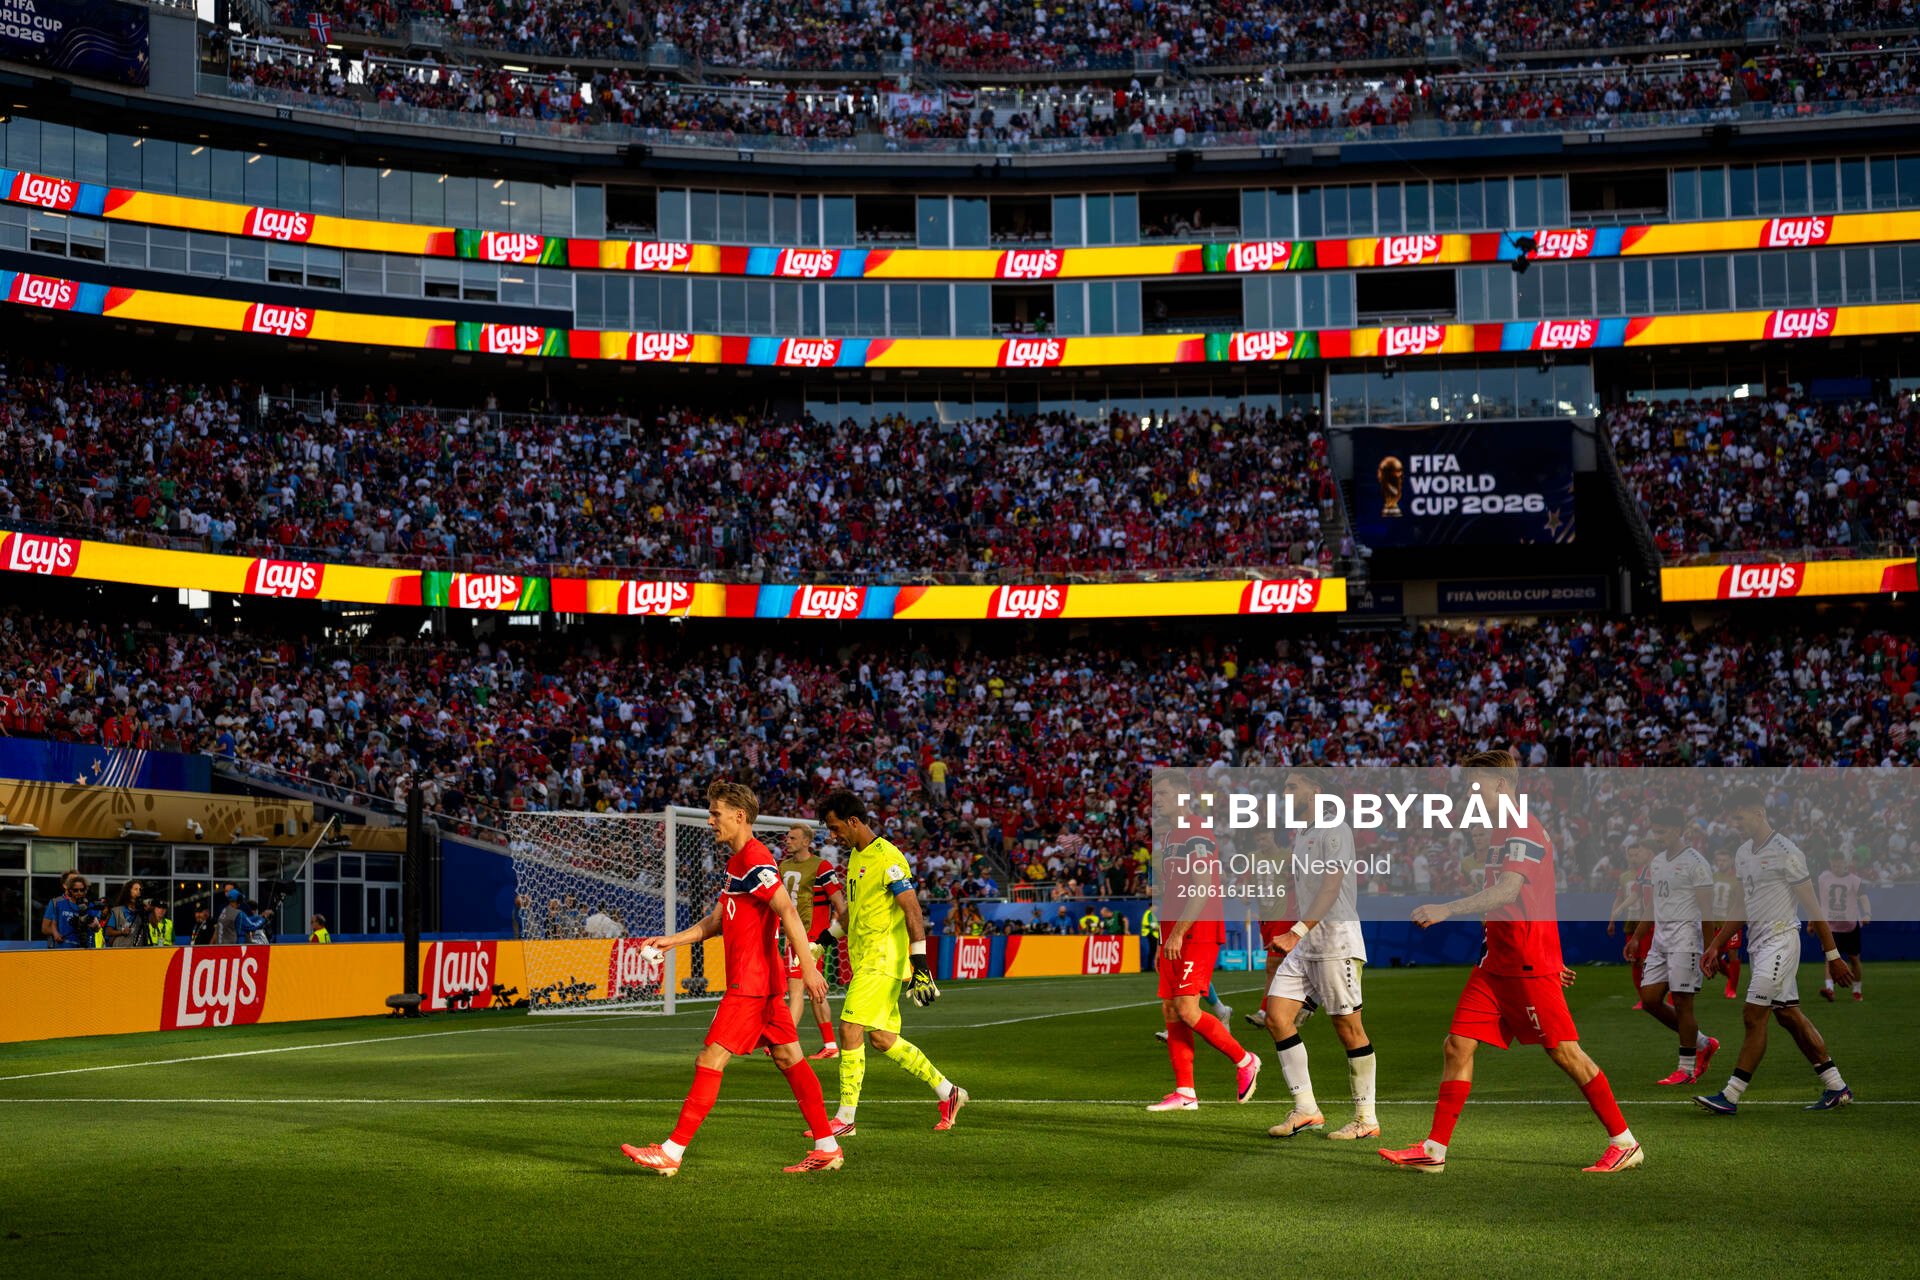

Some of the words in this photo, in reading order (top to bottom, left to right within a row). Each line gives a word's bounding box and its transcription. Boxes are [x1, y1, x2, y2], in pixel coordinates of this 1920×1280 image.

[0, 8, 31, 25] RLD
[33, 15, 63, 32] CUP
[20, 173, 71, 207] Lay's
[253, 207, 306, 240] Lay's
[1769, 216, 1824, 246] Lay's
[1536, 229, 1588, 258] Lay's
[783, 249, 833, 278] Lay's
[1005, 250, 1056, 278] Lay's
[19, 273, 71, 308] Lay's
[253, 303, 306, 336] Lay's
[1540, 320, 1592, 349] Lay's
[1774, 308, 1829, 338] Lay's
[784, 338, 835, 367] Lay's
[1006, 338, 1059, 367] Lay's
[1410, 453, 1460, 473] FIFA
[1410, 474, 1496, 494] WORLD
[1411, 496, 1458, 516] CUP
[1461, 493, 1545, 514] 2026
[10, 533, 72, 574] Lay's
[254, 559, 316, 597] Lay's
[1729, 562, 1795, 598] Lay's
[799, 584, 858, 619] Lay's
[997, 584, 1060, 618] Lay's
[1249, 576, 1313, 613] Lay's
[1447, 591, 1473, 602] FIFA
[1476, 590, 1522, 601] WORLD
[1524, 588, 1550, 600] CUP
[1552, 587, 1597, 599] 2026
[1658, 880, 1670, 898] 23
[957, 936, 986, 978] Lay's
[1087, 935, 1120, 974] Lay's
[432, 942, 489, 1009] Lay's
[1183, 961, 1194, 980] 7
[176, 946, 258, 1027] Lay's
